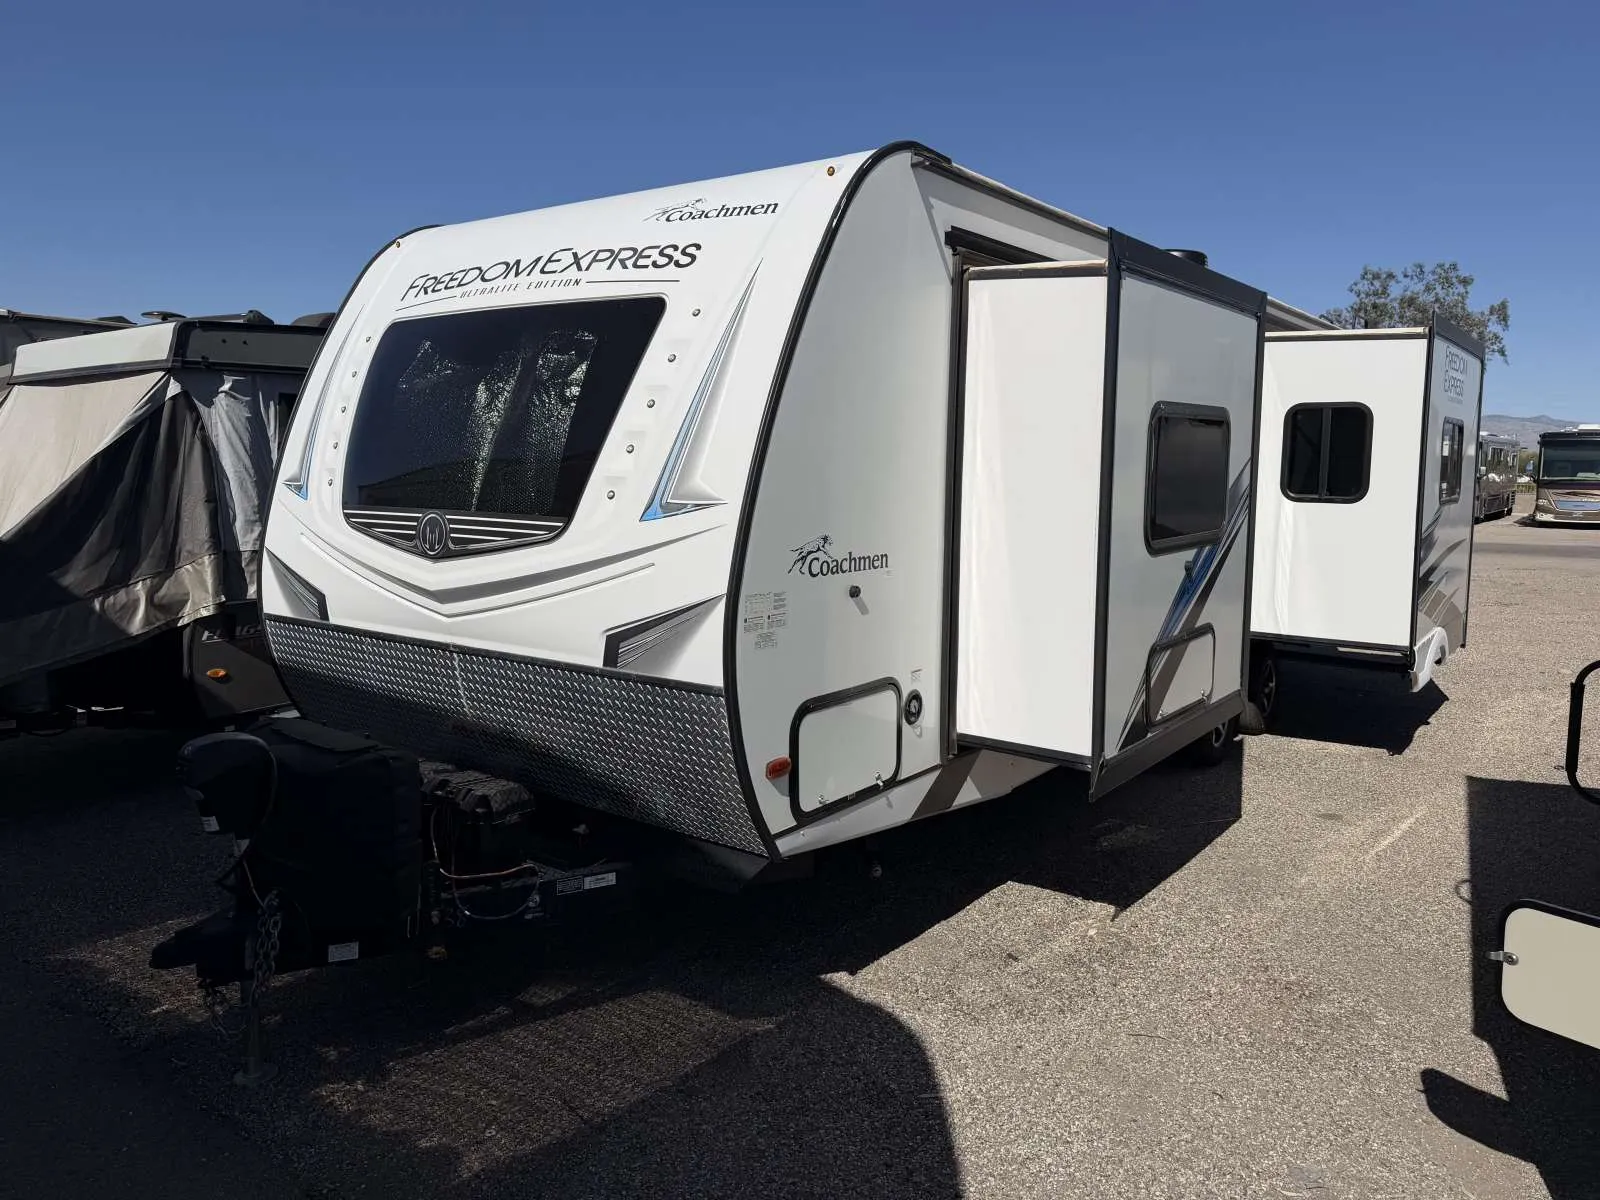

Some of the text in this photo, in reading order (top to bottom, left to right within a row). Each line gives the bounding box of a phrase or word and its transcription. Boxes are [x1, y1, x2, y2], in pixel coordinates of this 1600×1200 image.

[666, 201, 779, 223] Coachmen
[460, 278, 582, 299] ULTRALITE EDITION
[808, 551, 889, 578] Coachmen
